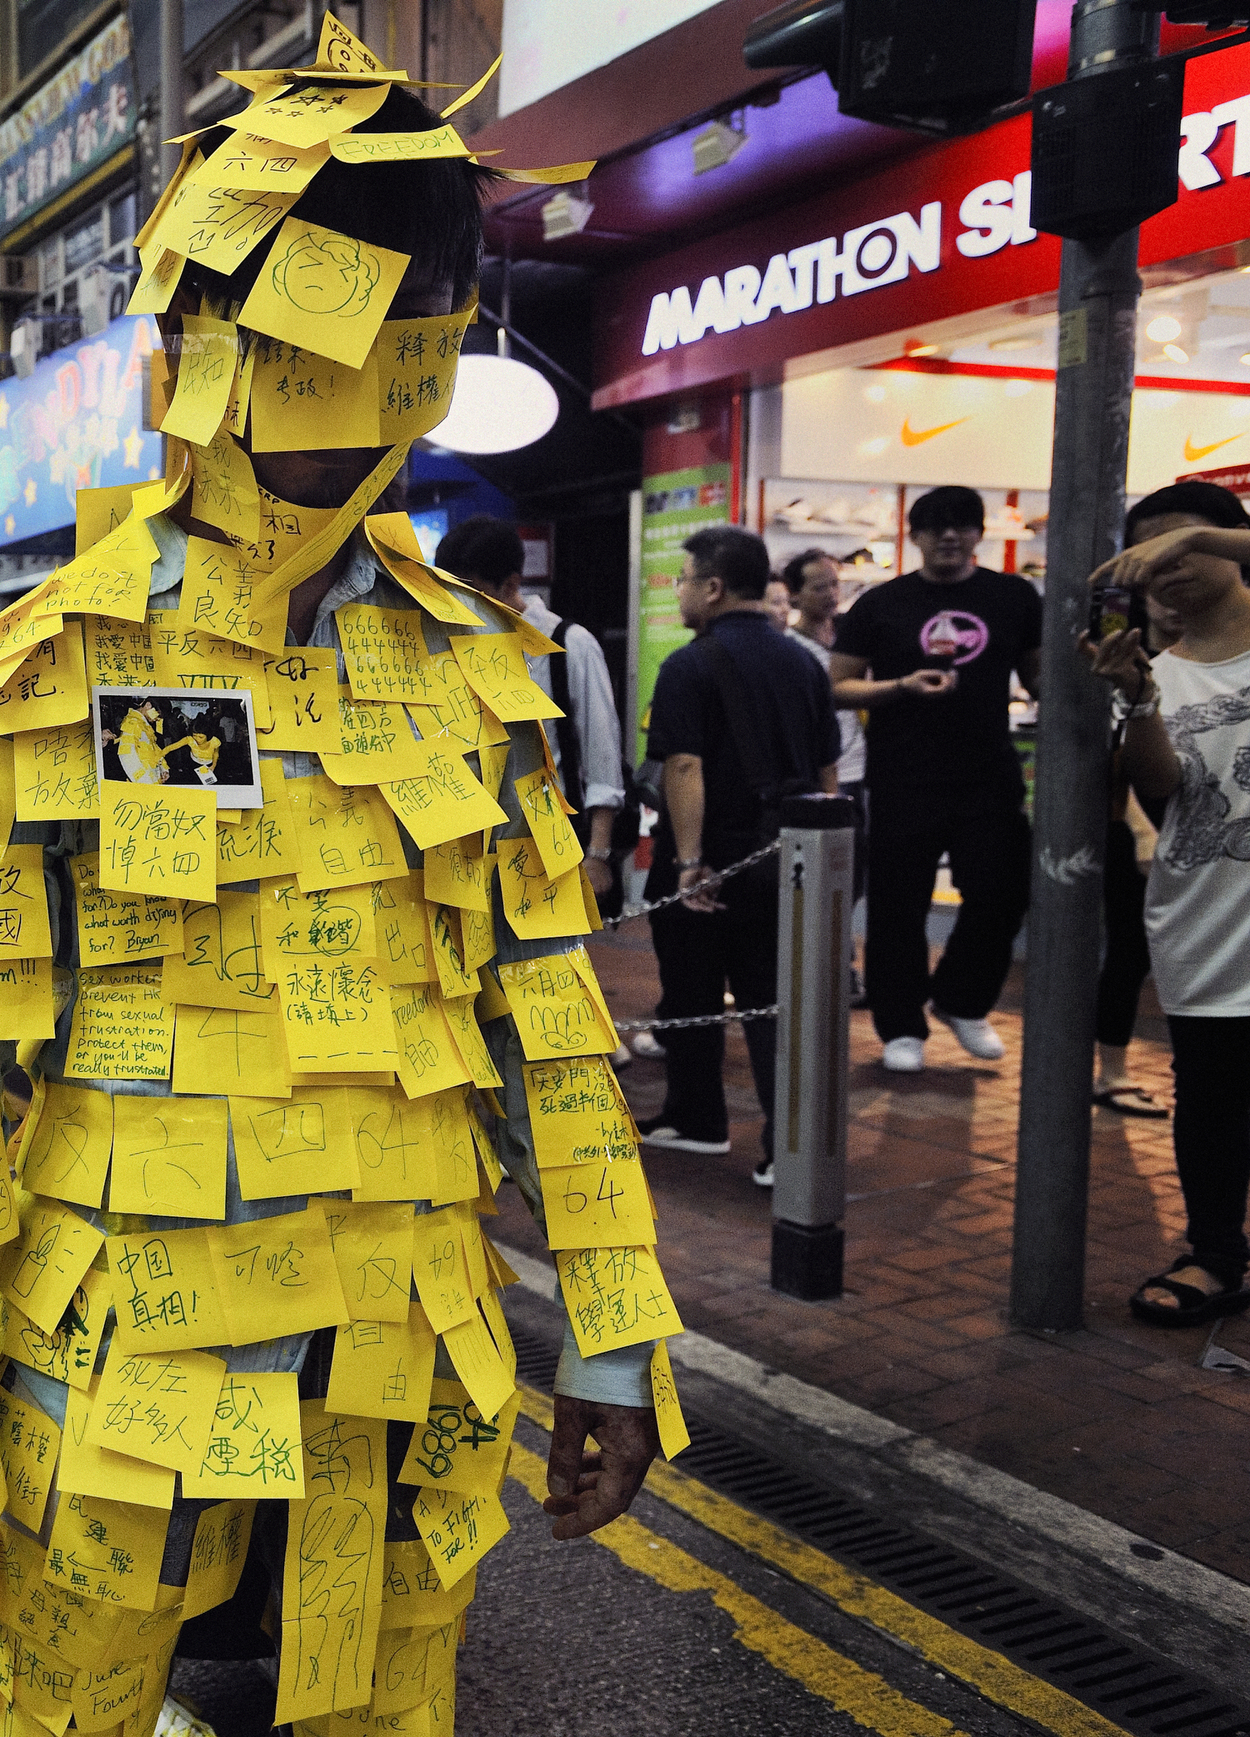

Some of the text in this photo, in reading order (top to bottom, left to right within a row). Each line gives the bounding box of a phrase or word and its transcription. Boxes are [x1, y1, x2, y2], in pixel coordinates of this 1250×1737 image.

[337, 130, 454, 158] FREEDOM
[223, 151, 298, 174] 六四
[641, 201, 942, 356] MARATHON
[193, 589, 263, 639] 良知
[320, 838, 395, 875] 自由
[121, 900, 141, 913] you
[89, 930, 160, 954] for? Bryan
[80, 990, 137, 1006] prevent
[120, 1006, 165, 1023] sexual
[72, 1061, 110, 1077] really
[135, 1051, 148, 1062] be
[247, 1102, 327, 1163] 四
[129, 1116, 205, 1200] 六
[127, 1288, 200, 1333] 真相!
[191, 1508, 246, 1575] 維權
